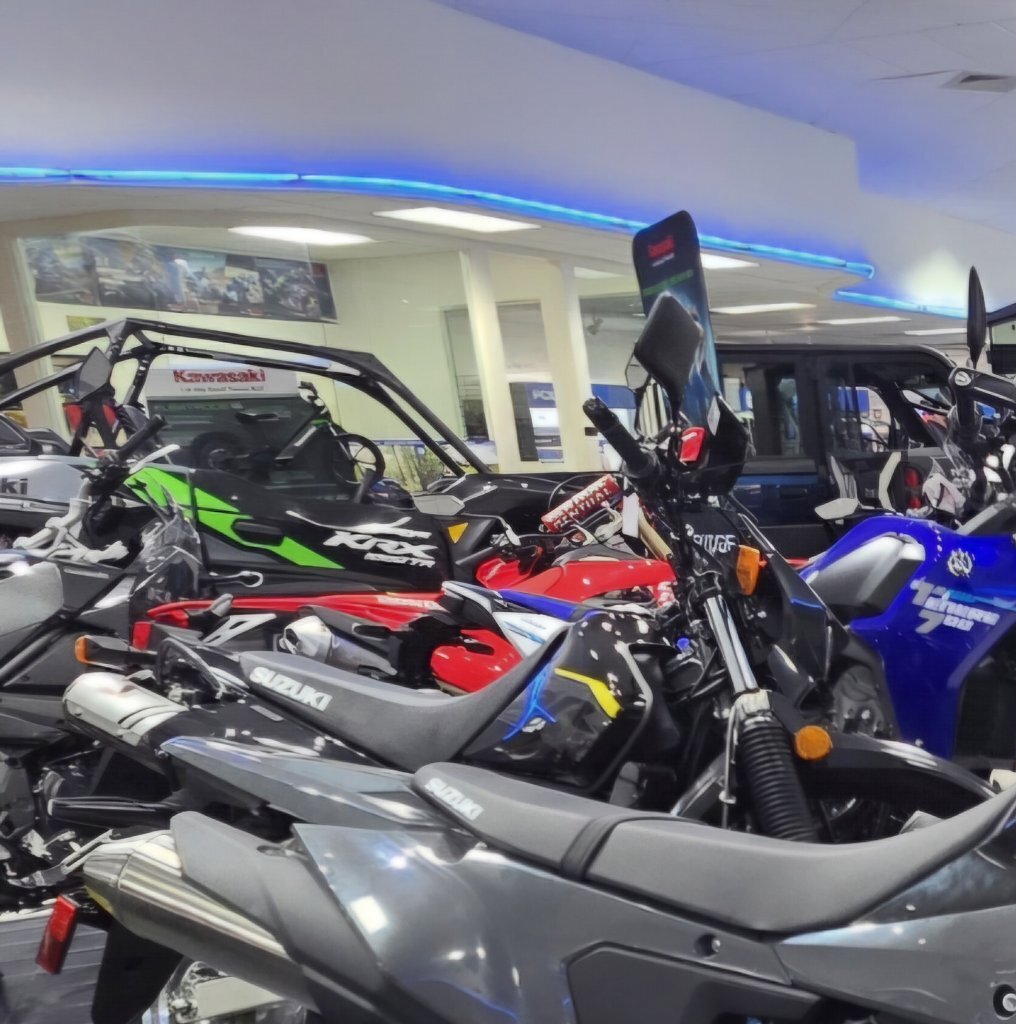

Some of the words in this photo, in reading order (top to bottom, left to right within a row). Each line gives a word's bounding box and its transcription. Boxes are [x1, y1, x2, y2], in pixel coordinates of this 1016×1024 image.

[172, 369, 267, 383] Kawasaki
[249, 666, 334, 712] SUZUKI
[424, 777, 485, 821] SUZUKI
